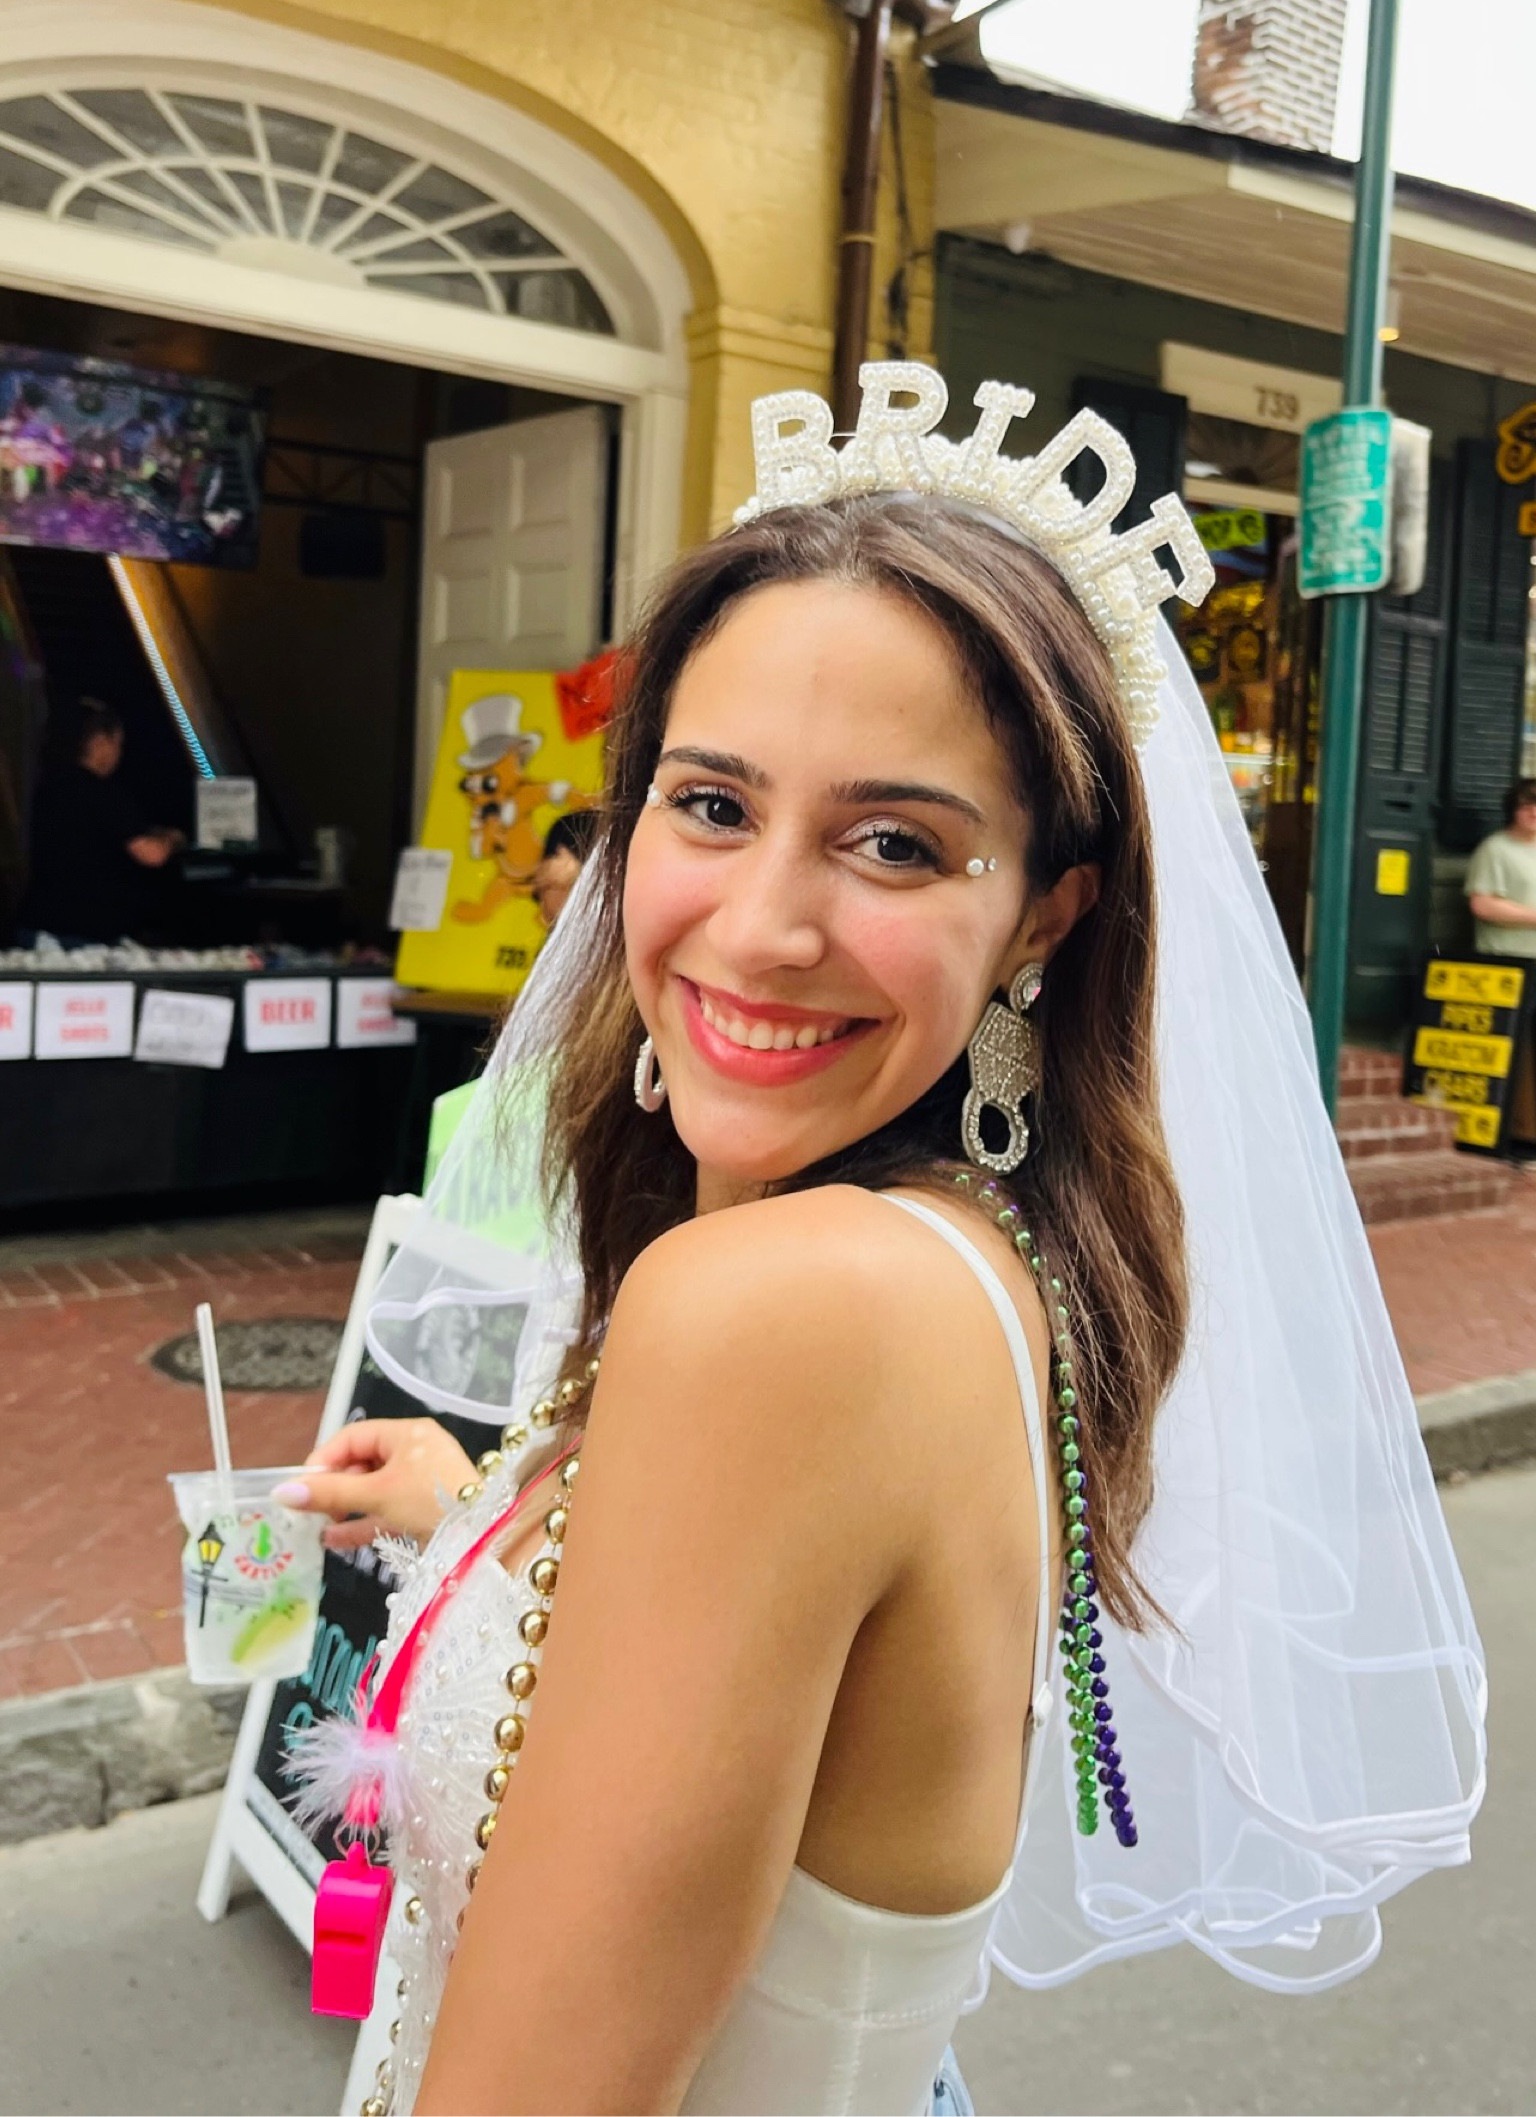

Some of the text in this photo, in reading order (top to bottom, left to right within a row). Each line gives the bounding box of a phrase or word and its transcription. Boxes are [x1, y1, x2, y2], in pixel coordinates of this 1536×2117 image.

[1254, 386, 1299, 421] 739
[751, 361, 1216, 608] BRIDE
[260, 996, 316, 1025] BEER
